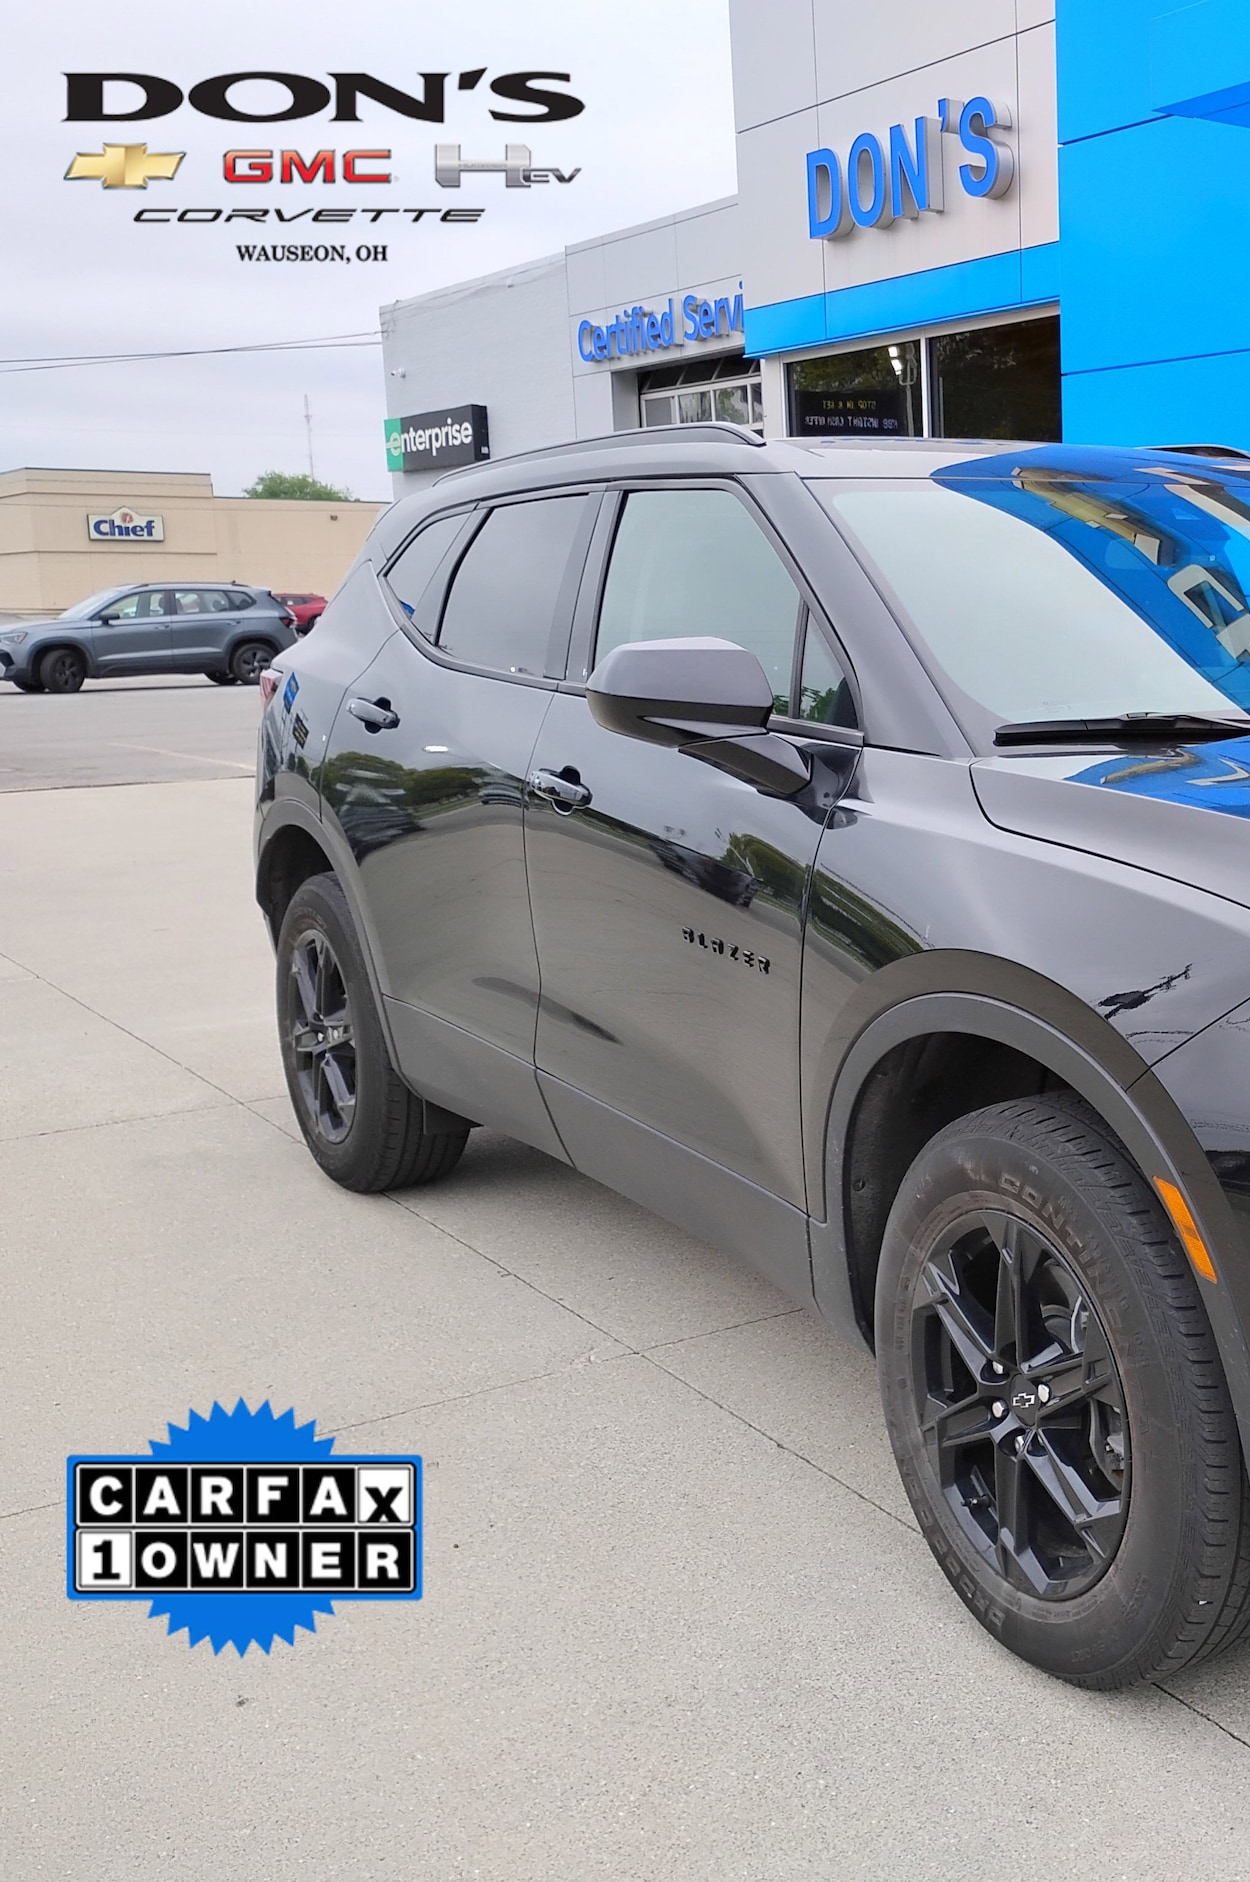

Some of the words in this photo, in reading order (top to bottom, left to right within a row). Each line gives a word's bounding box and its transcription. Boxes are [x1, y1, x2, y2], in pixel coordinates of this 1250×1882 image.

[806, 96, 1005, 240] DON'S
[578, 298, 675, 362] Certified
[386, 417, 473, 457] enterprise
[93, 519, 155, 537] Chief
[682, 926, 771, 975] BLAZER
